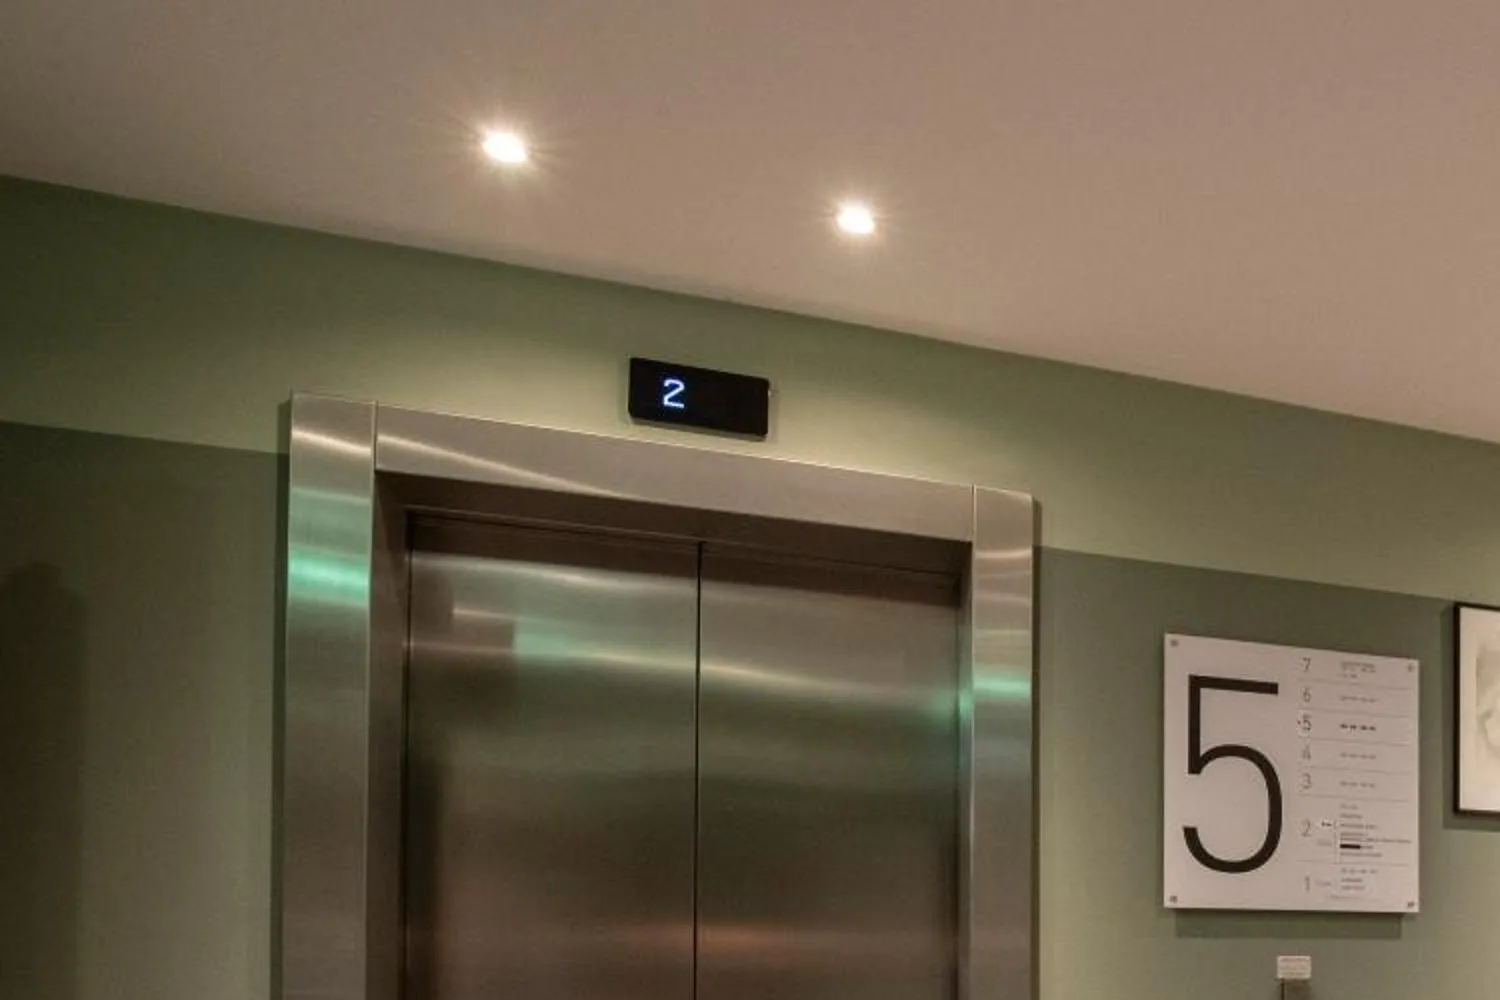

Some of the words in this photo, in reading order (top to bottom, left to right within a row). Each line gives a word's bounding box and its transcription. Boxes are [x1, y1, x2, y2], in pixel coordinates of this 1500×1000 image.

[662, 378, 685, 409] 2
[1302, 657, 1312, 673] 7
[1302, 687, 1312, 703] 6
[1301, 714, 1313, 731] 5
[1183, 674, 1283, 874] 5
[1301, 819, 1312, 837] 2
